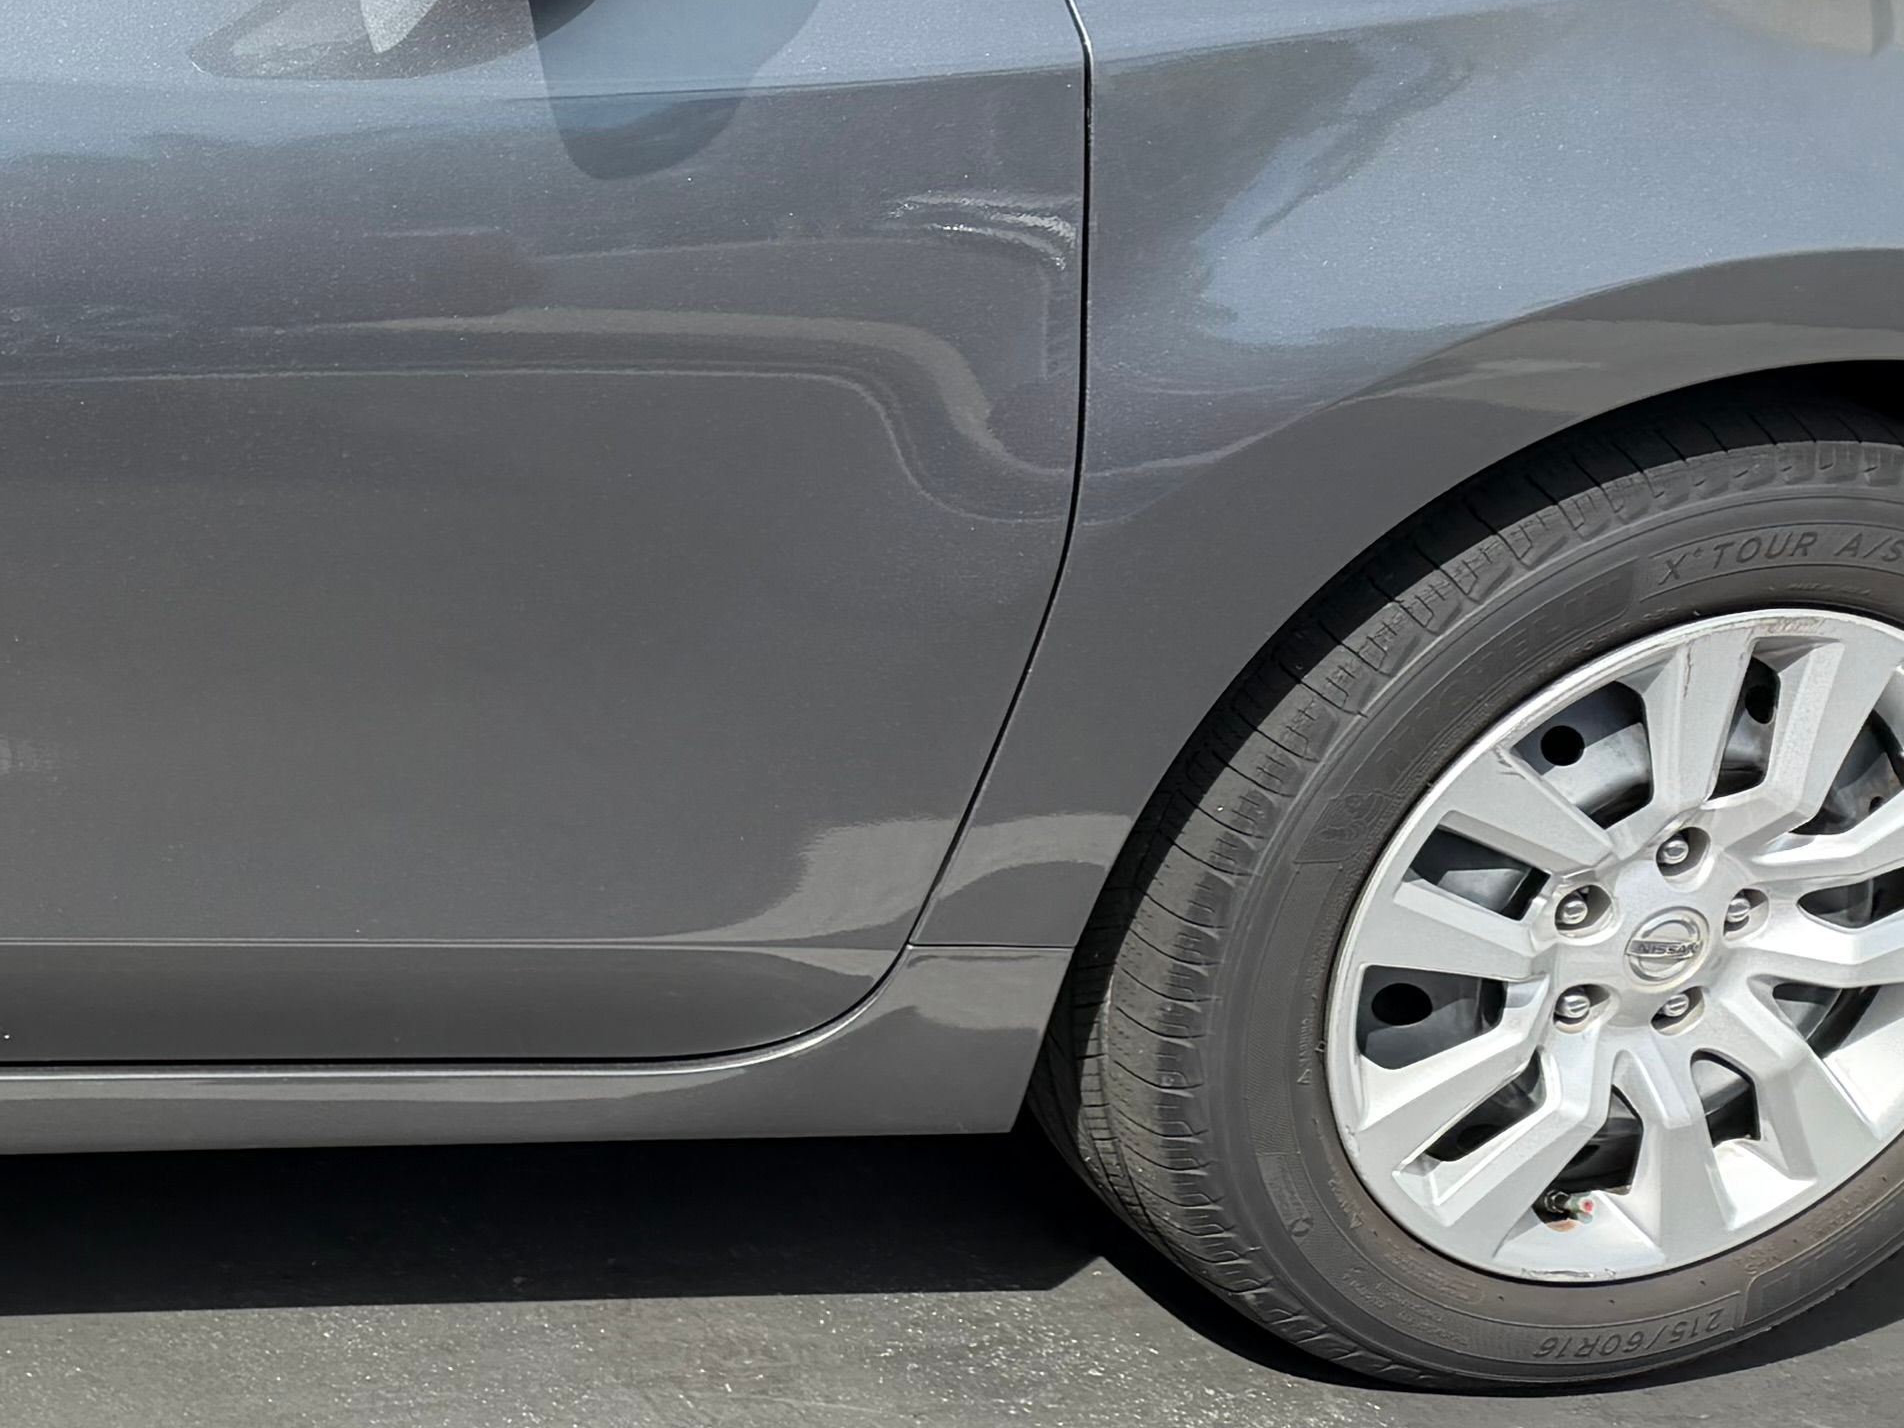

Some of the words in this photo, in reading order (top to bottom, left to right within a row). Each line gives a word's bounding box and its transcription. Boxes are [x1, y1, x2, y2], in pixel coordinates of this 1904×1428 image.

[1713, 532, 1818, 569] TOUR
[1638, 939, 1700, 955] NISSAN
[1532, 1306, 1725, 1360] 215/60R16
